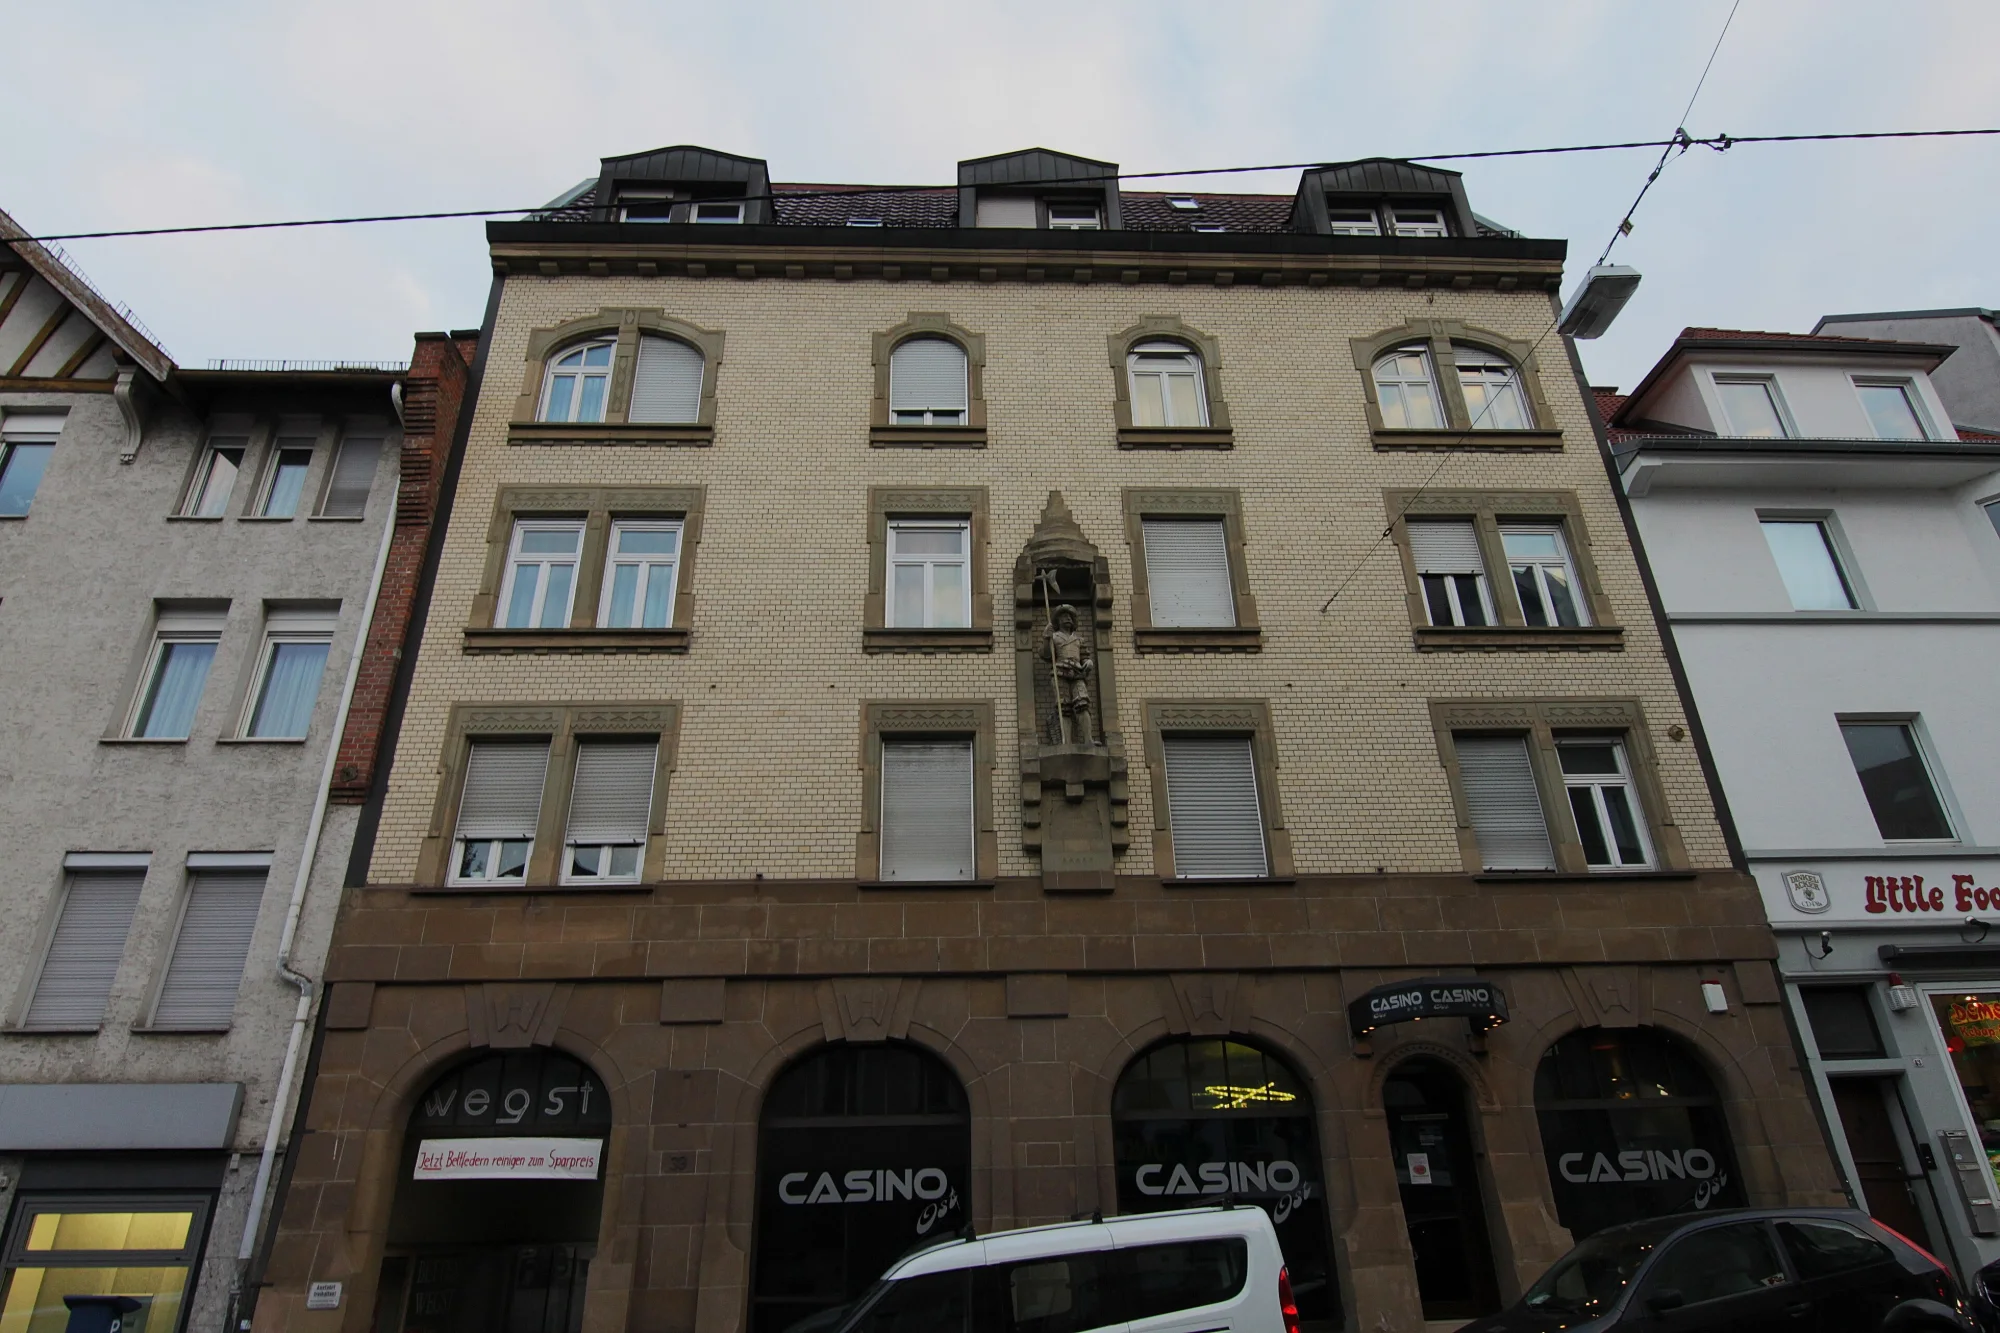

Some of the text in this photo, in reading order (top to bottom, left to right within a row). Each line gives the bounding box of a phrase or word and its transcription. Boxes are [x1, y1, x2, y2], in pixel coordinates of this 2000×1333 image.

[1790, 874, 1819, 884] DINKEL
[1794, 881, 1820, 891] ACKER
[1864, 874, 1944, 914] Little
[1370, 991, 1423, 1013] CASINO
[1430, 988, 1489, 1003] CASINO
[424, 1081, 594, 1124] wegst
[418, 1148, 595, 1173] Jetzt Bettfedern reinigen zum Sparpreis
[1135, 1160, 1312, 1225] CASINO Ost
[1558, 1148, 1728, 1210] CASINO Ost
[778, 1167, 961, 1235] CASINO Ost
